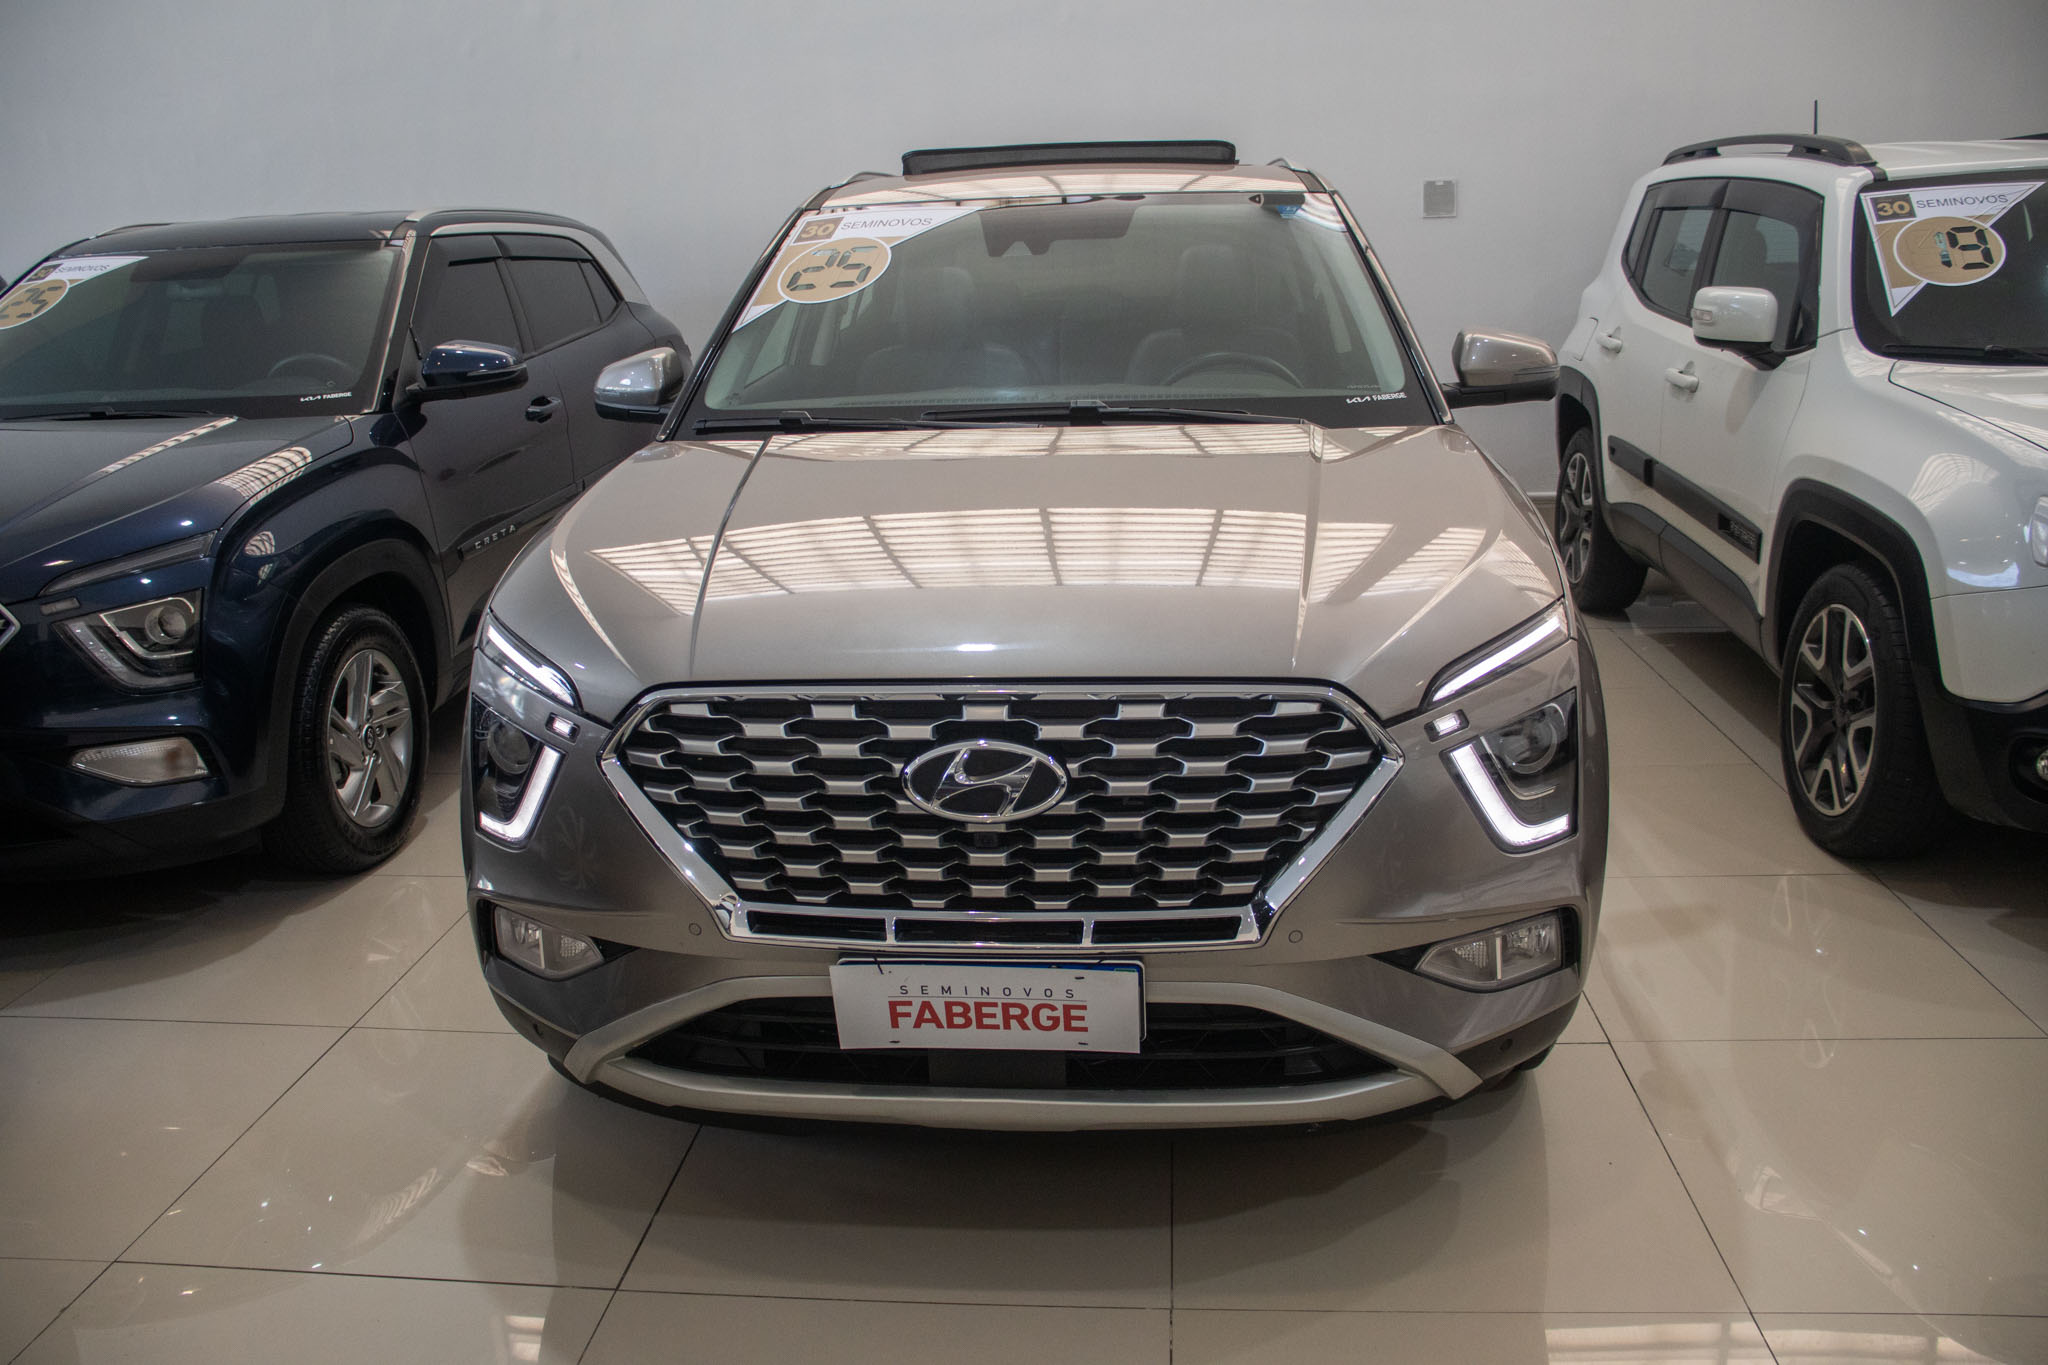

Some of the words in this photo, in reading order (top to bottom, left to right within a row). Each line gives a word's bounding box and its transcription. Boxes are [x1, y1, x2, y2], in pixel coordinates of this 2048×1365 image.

[1877, 200, 1911, 216] 30
[1916, 194, 2009, 209] SEMINOVOS
[800, 223, 835, 238] 30
[841, 217, 933, 231] SEMINOVOS
[475, 525, 516, 549] CRETA
[900, 984, 1075, 999] SEMINOVOS
[888, 1000, 1088, 1032] FABERGE
